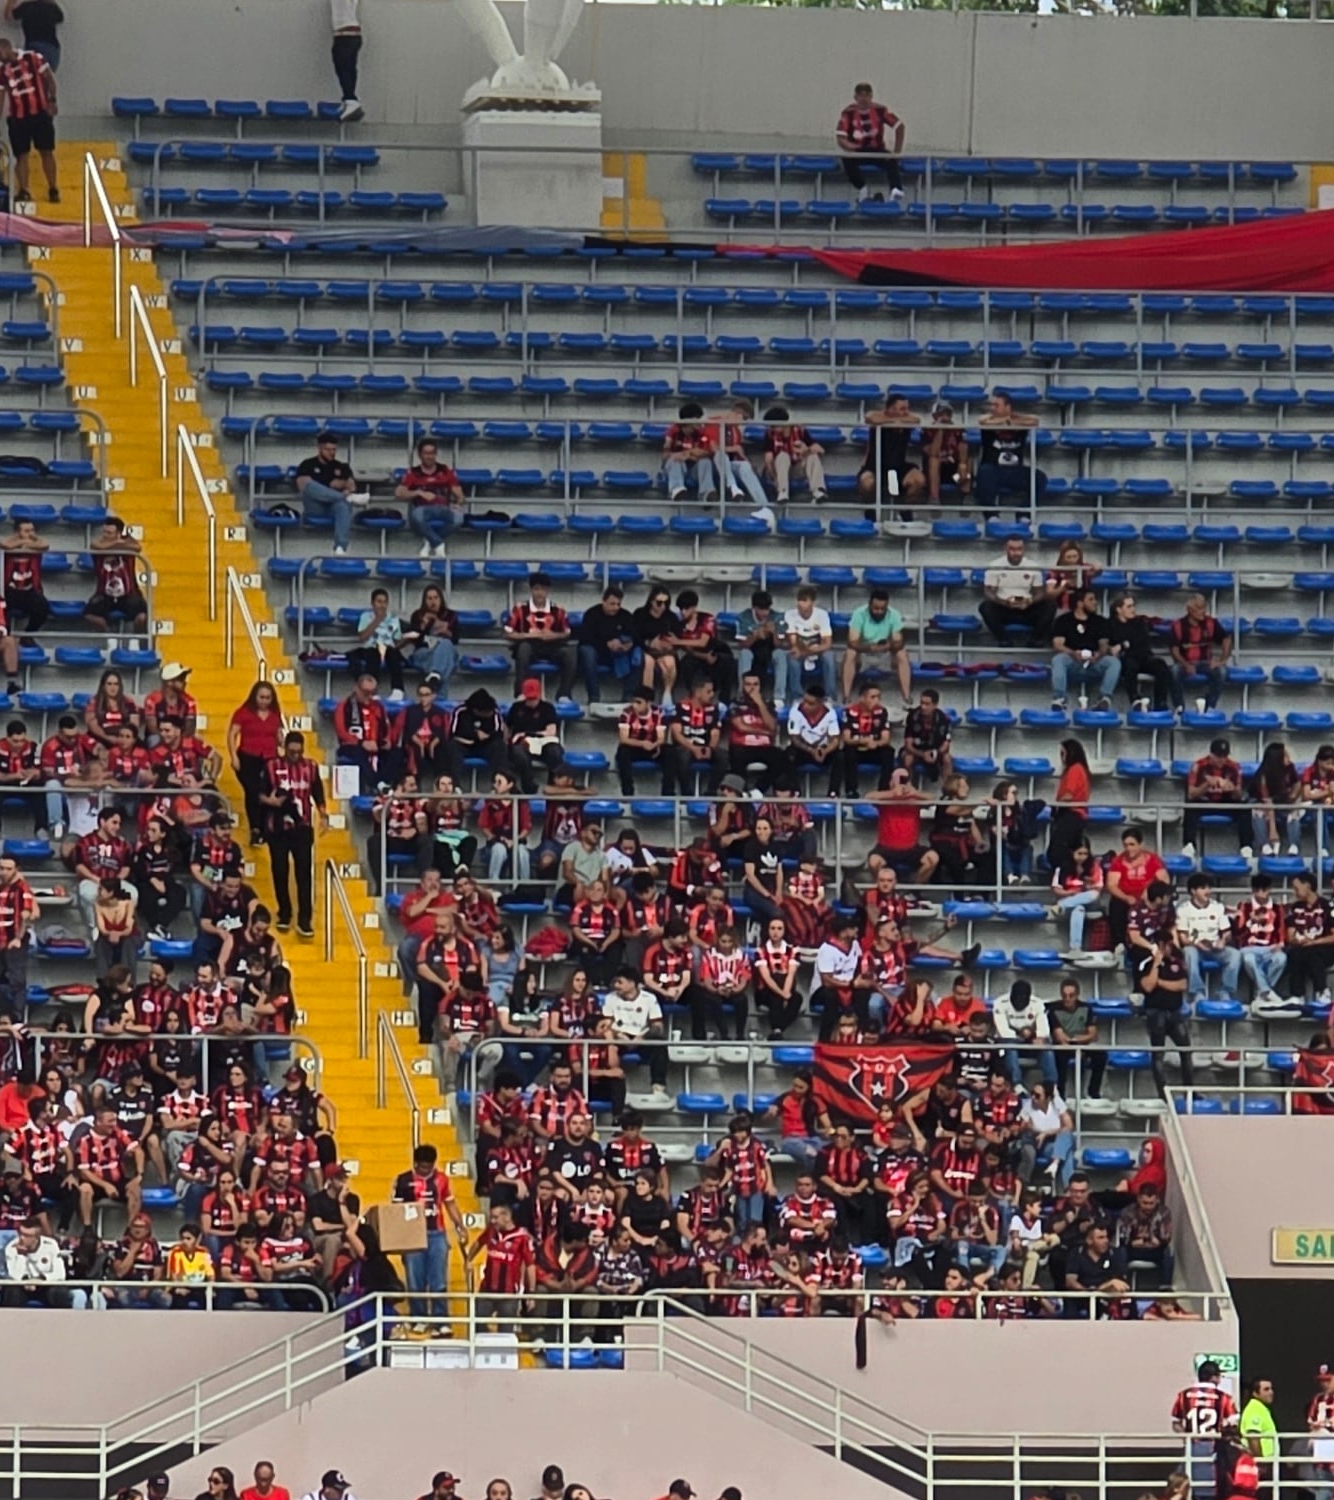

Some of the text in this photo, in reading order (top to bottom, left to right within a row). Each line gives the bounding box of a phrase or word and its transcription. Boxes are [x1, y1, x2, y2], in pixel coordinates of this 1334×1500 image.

[38, 247, 48, 259] X
[132, 248, 142, 260] X
[78, 387, 88, 398] U
[178, 388, 187, 400] U
[228, 529, 236, 540] R
[292, 718, 302, 729] N
[343, 864, 351, 876] K
[1186, 1407, 1218, 1434] 12
